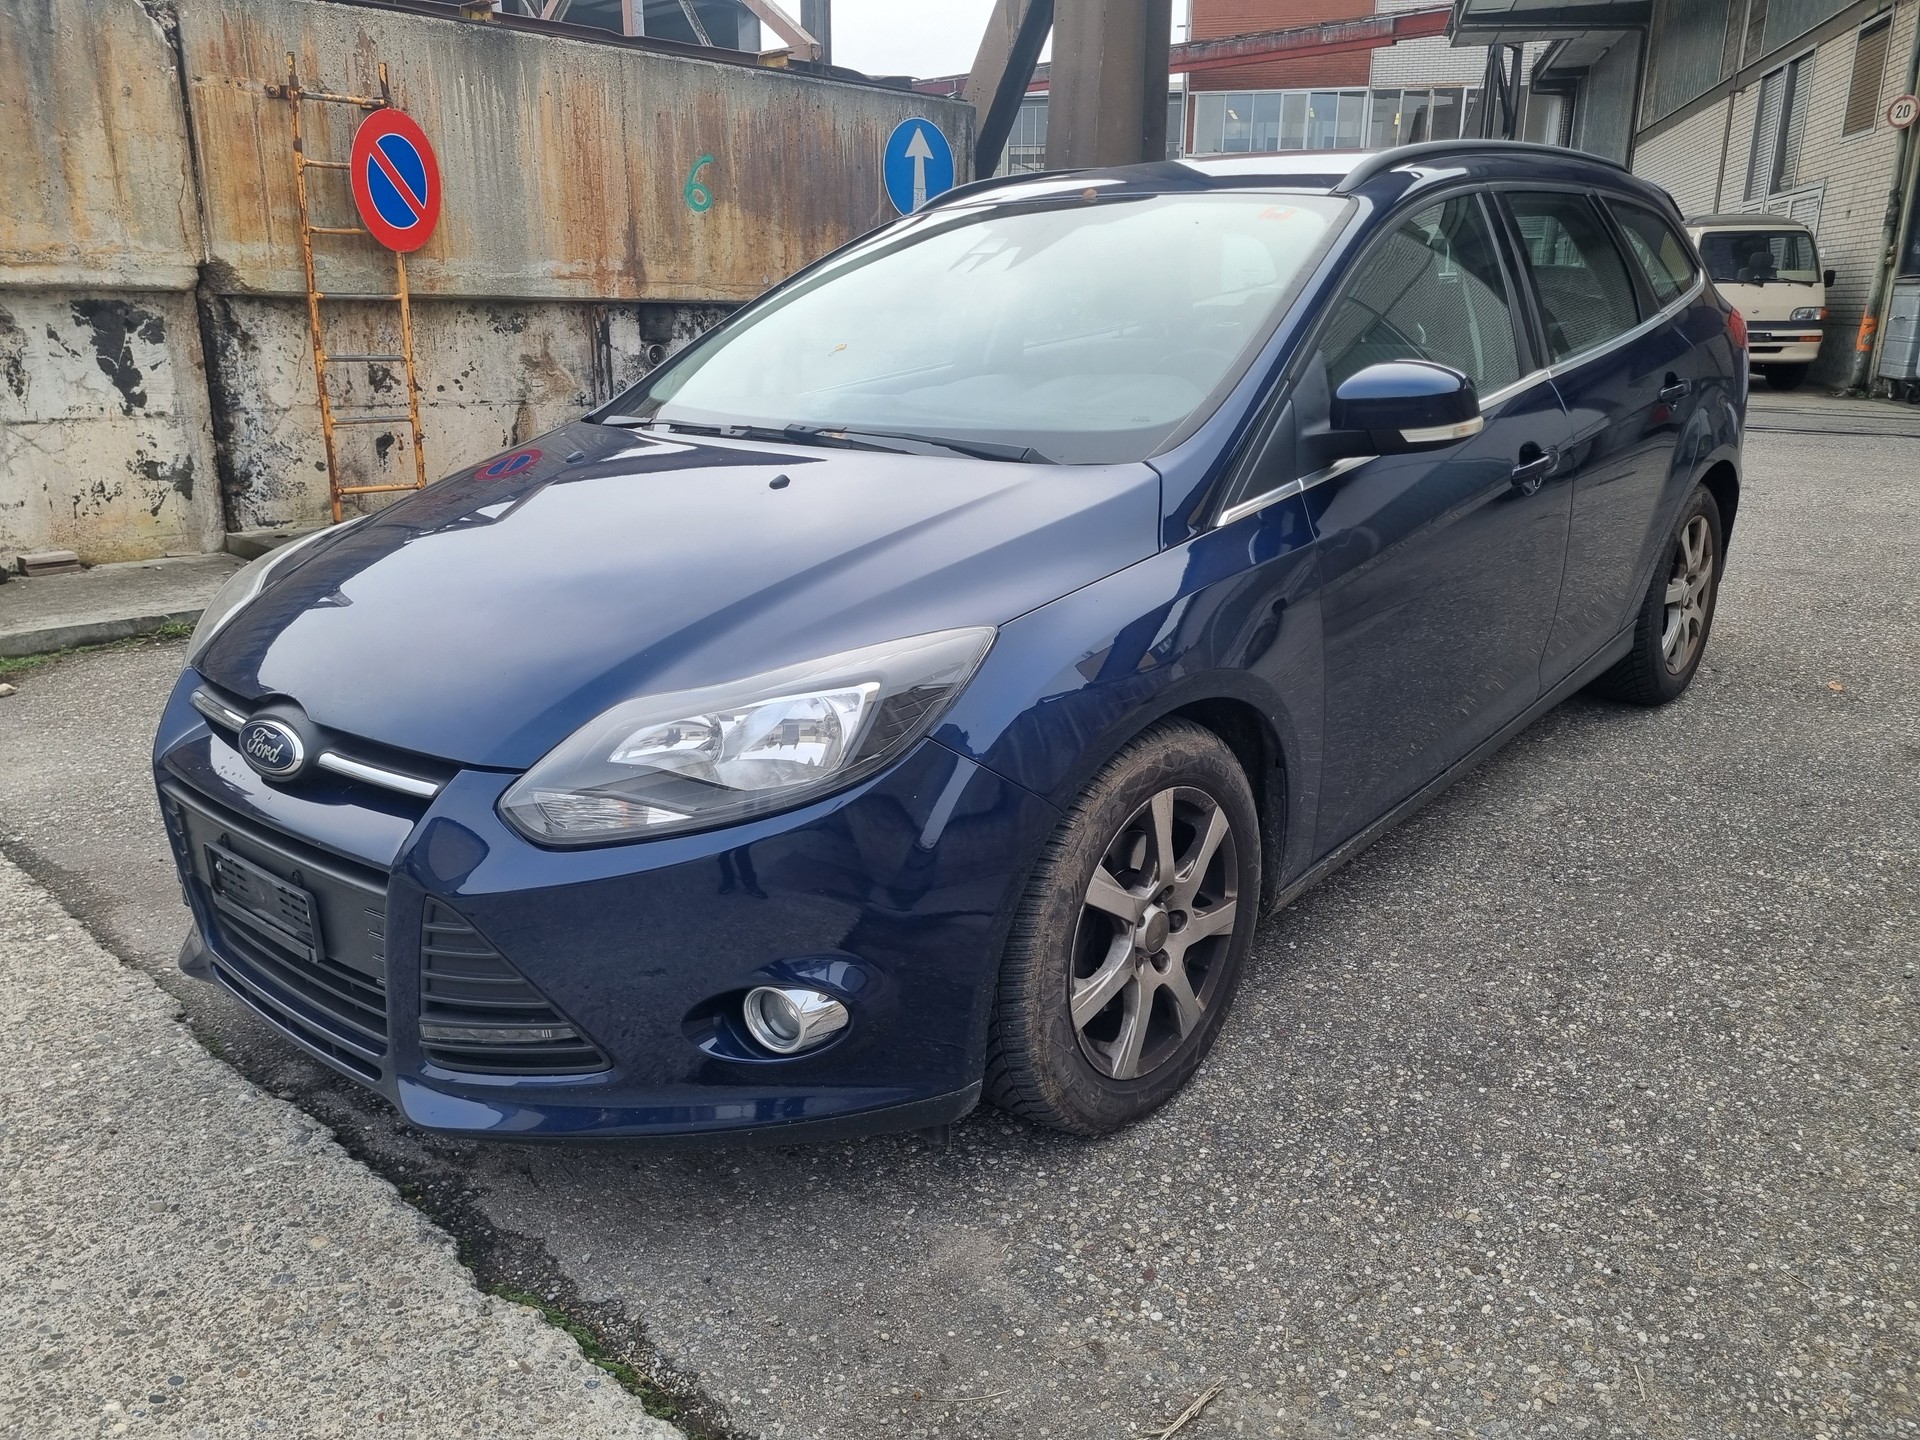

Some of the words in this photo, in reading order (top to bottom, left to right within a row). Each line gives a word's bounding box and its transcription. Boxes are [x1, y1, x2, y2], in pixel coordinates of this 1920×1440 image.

[1895, 104, 1911, 119] 20
[684, 153, 714, 212] 6
[247, 727, 283, 763] Ford
